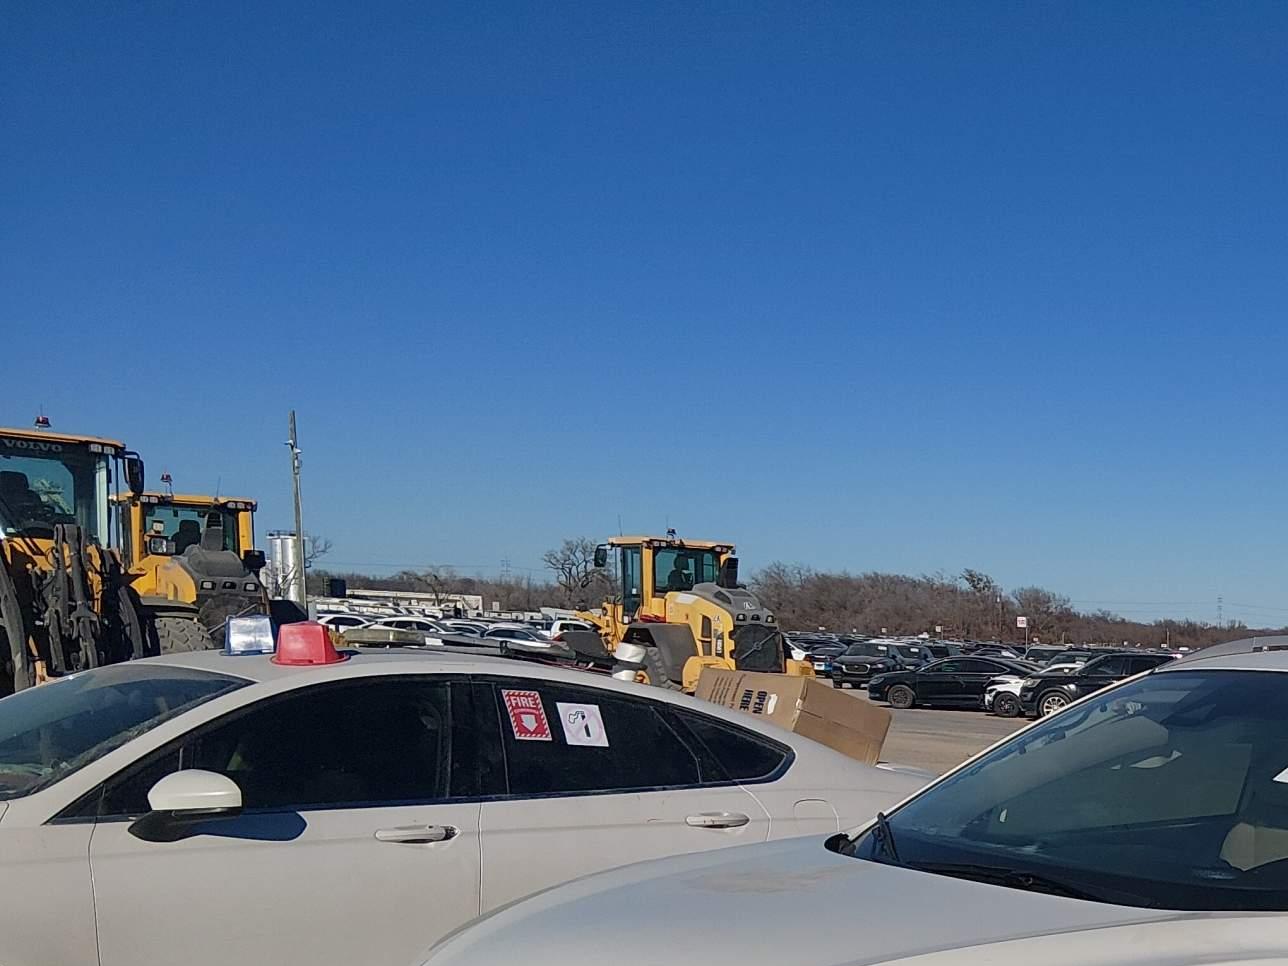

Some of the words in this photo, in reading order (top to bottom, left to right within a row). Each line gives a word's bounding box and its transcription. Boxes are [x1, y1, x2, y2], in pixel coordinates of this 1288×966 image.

[2, 439, 62, 452] VOLVO
[509, 696, 538, 708] FIRE
[739, 689, 754, 711] HERE
[752, 690, 768, 714] OPEN
